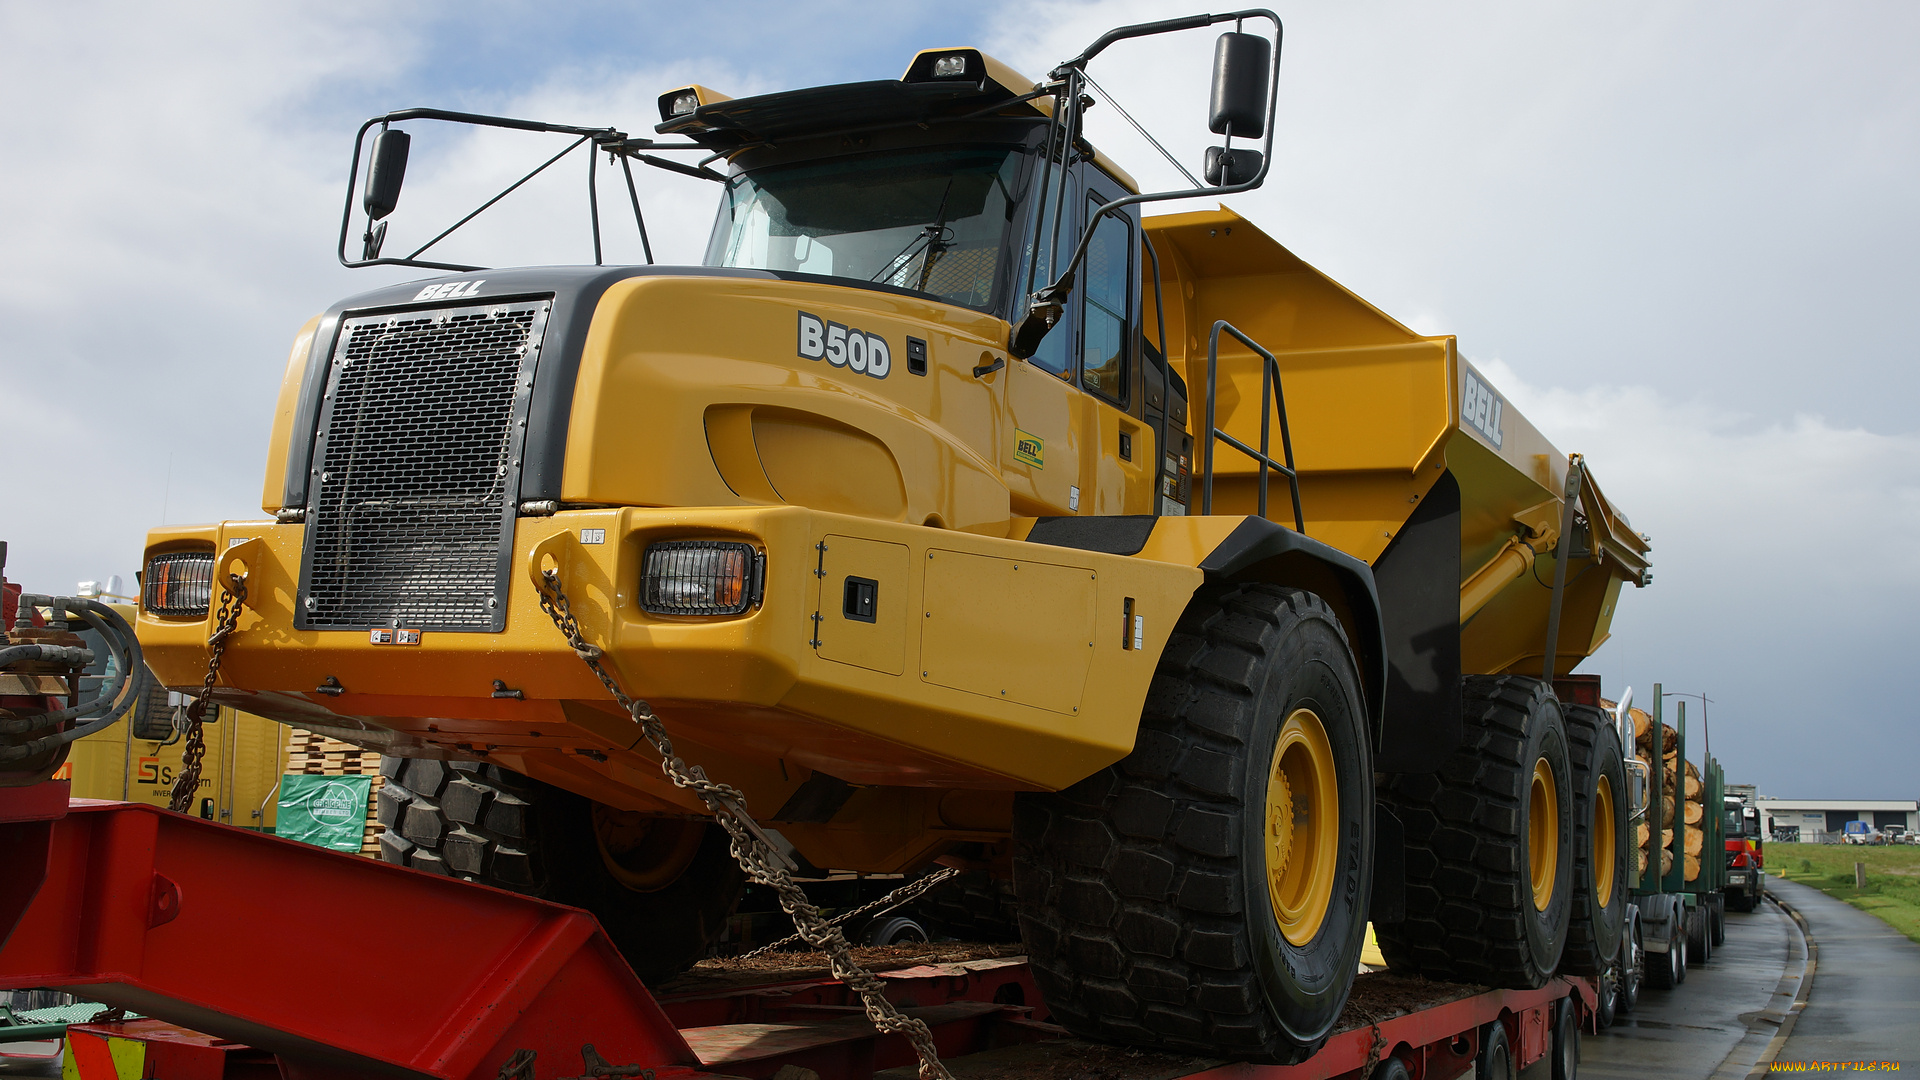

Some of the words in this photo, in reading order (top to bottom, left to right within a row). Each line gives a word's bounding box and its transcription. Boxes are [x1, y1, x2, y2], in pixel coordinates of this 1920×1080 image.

[413, 280, 486, 301] BELL
[798, 311, 890, 379] B50D
[1462, 369, 1503, 449] BELL
[1018, 440, 1036, 457] BELL
